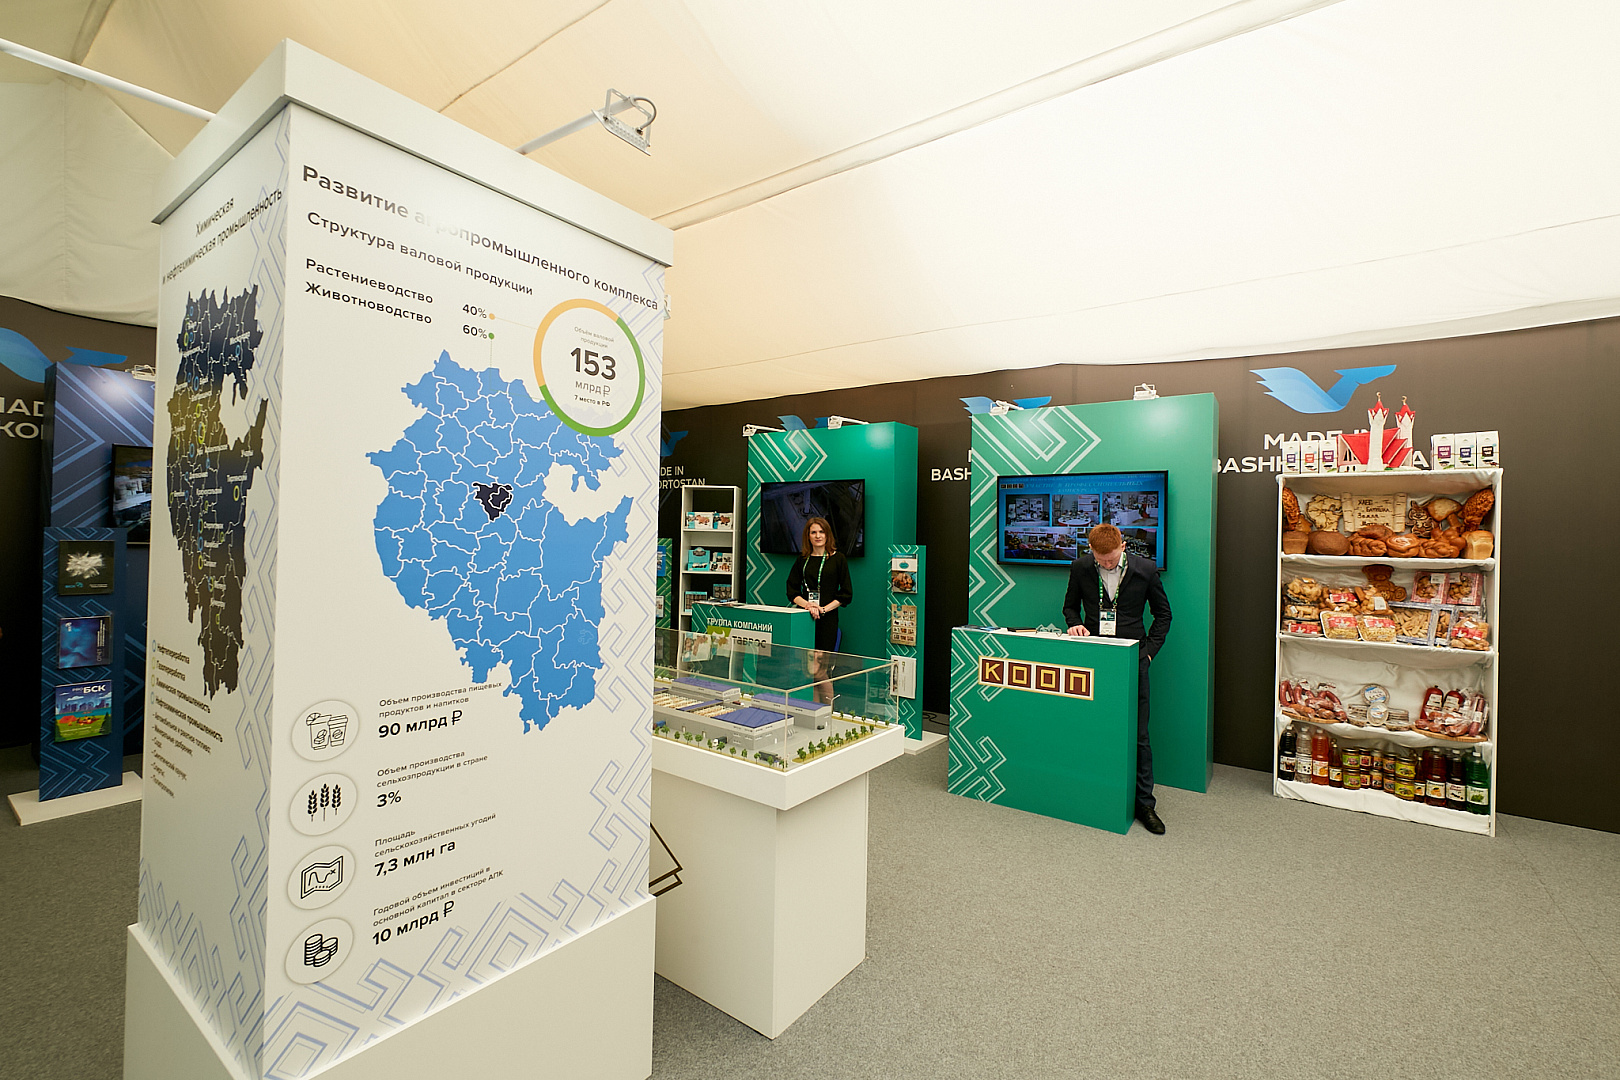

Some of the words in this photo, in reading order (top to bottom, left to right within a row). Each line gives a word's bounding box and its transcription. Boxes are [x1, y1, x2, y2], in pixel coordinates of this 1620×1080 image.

[217, 188, 282, 247] промышленность
[303, 165, 408, 218] Развитие
[594, 278, 659, 311] комплекса
[307, 211, 395, 252] Структура
[400, 243, 462, 273] валовой
[466, 266, 534, 296] продукции
[305, 258, 434, 304] Растениеводство
[305, 281, 432, 325] Животноводство
[462, 304, 488, 319] 40%
[462, 324, 488, 340] 60%
[570, 348, 616, 380] 153
[579, 397, 596, 405] место
[659, 478, 706, 490] ORTOSTAN
[660, 466, 672, 476] DE
[674, 466, 684, 476] IN
[706, 618, 732, 628] ГРУППА
[734, 620, 773, 632] КОМПАНИЙ
[84, 684, 106, 694] БСК
[380, 696, 410, 707] Объем
[412, 687, 467, 702] производства
[468, 682, 502, 692] пищевых
[378, 704, 424, 718] продуктов
[434, 696, 470, 709] напитков
[378, 722, 400, 738] 90
[406, 716, 448, 734] млрд
[376, 764, 408, 778] Объем
[409, 751, 466, 770] производства
[376, 763, 455, 788] сельхозпродукции
[462, 754, 488, 766] стране
[376, 790, 402, 808] 3%
[374, 822, 470, 858] сельскохозяйственных
[470, 812, 496, 828] угодий
[374, 830, 416, 847] Площадь
[374, 858, 398, 877] 7,3
[403, 848, 436, 868] млн
[440, 841, 456, 855] га
[372, 906, 415, 928] основной
[416, 892, 450, 911] капитал
[457, 878, 487, 894] секторе
[488, 870, 504, 882] АПК
[373, 896, 410, 916] Годовой
[412, 884, 438, 902] объем
[440, 868, 484, 890] инвестиций
[372, 928, 392, 946] 10
[396, 910, 439, 936] млрд
